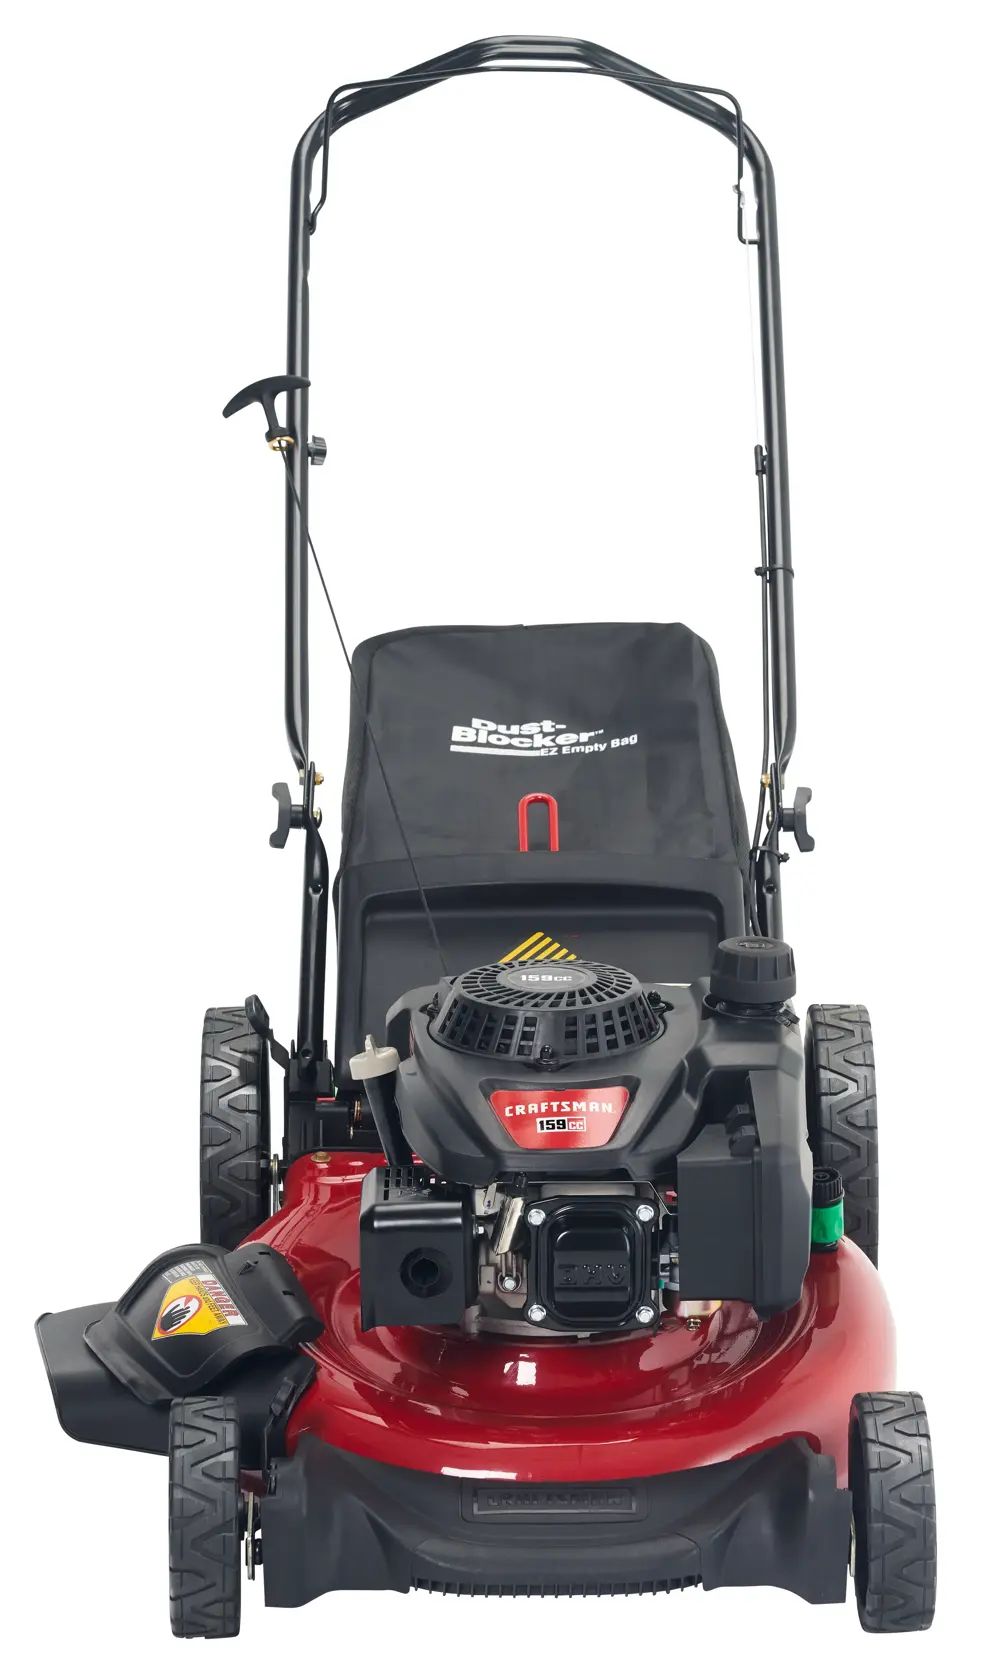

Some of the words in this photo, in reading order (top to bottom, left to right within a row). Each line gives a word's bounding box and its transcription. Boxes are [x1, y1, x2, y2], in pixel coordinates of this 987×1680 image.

[472, 718, 566, 735] Dust-
[540, 747, 558, 756] EZ
[562, 742, 607, 754] Empty
[611, 734, 638, 748] Bag
[505, 1101, 613, 1117] CRAFTSMAN
[202, 1280, 238, 1316] DANGER
